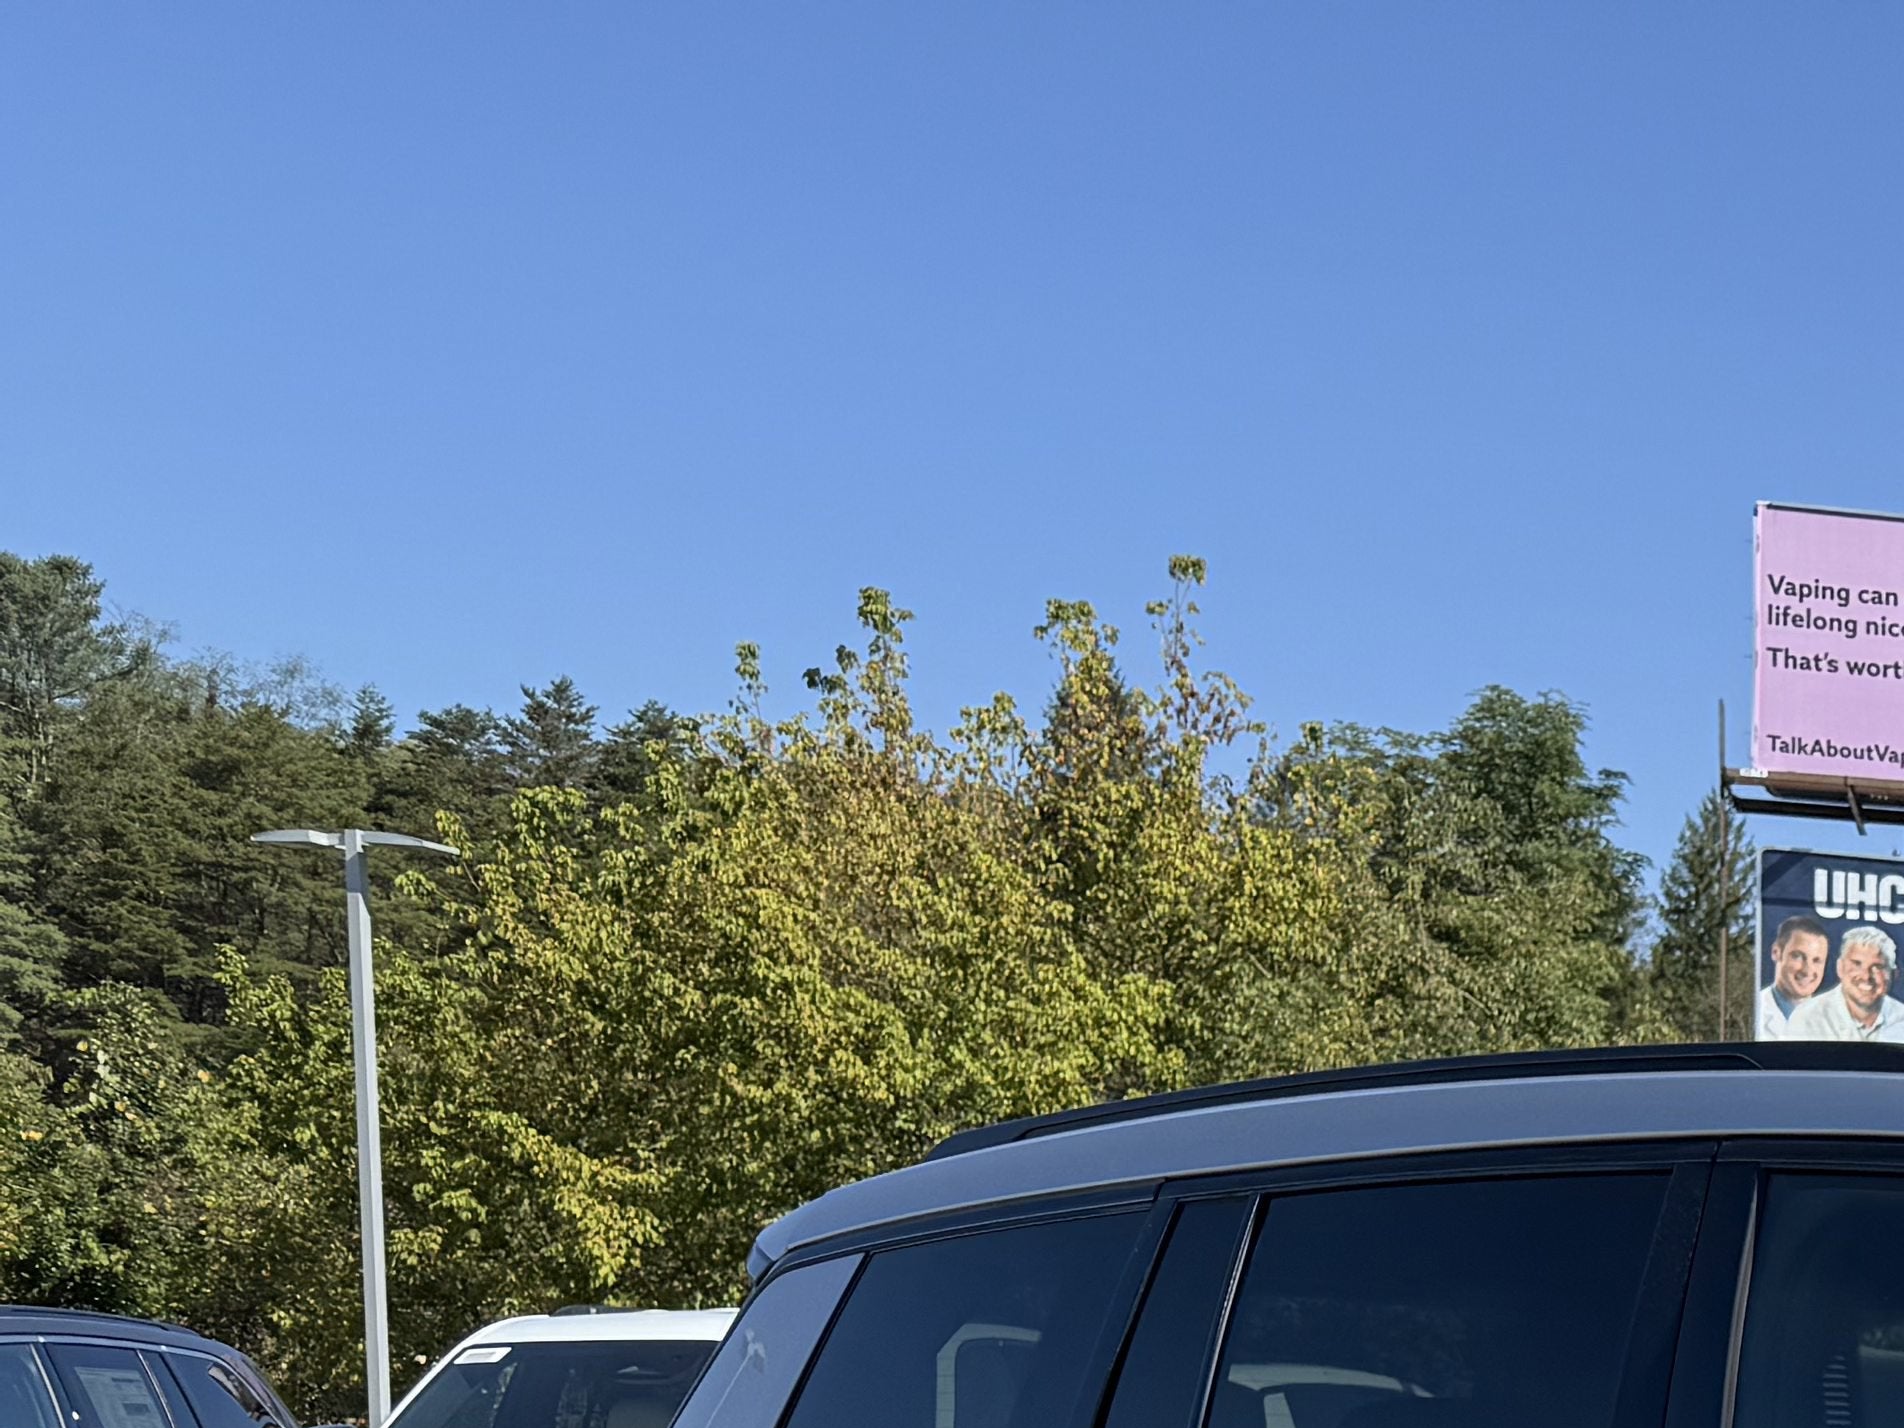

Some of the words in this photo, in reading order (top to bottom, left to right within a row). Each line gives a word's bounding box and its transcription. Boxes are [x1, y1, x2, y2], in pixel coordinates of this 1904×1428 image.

[1767, 574, 1851, 607] Vaping
[1858, 588, 1898, 607] can
[1767, 604, 1858, 639] lifelong
[1766, 647, 1839, 674] That's
